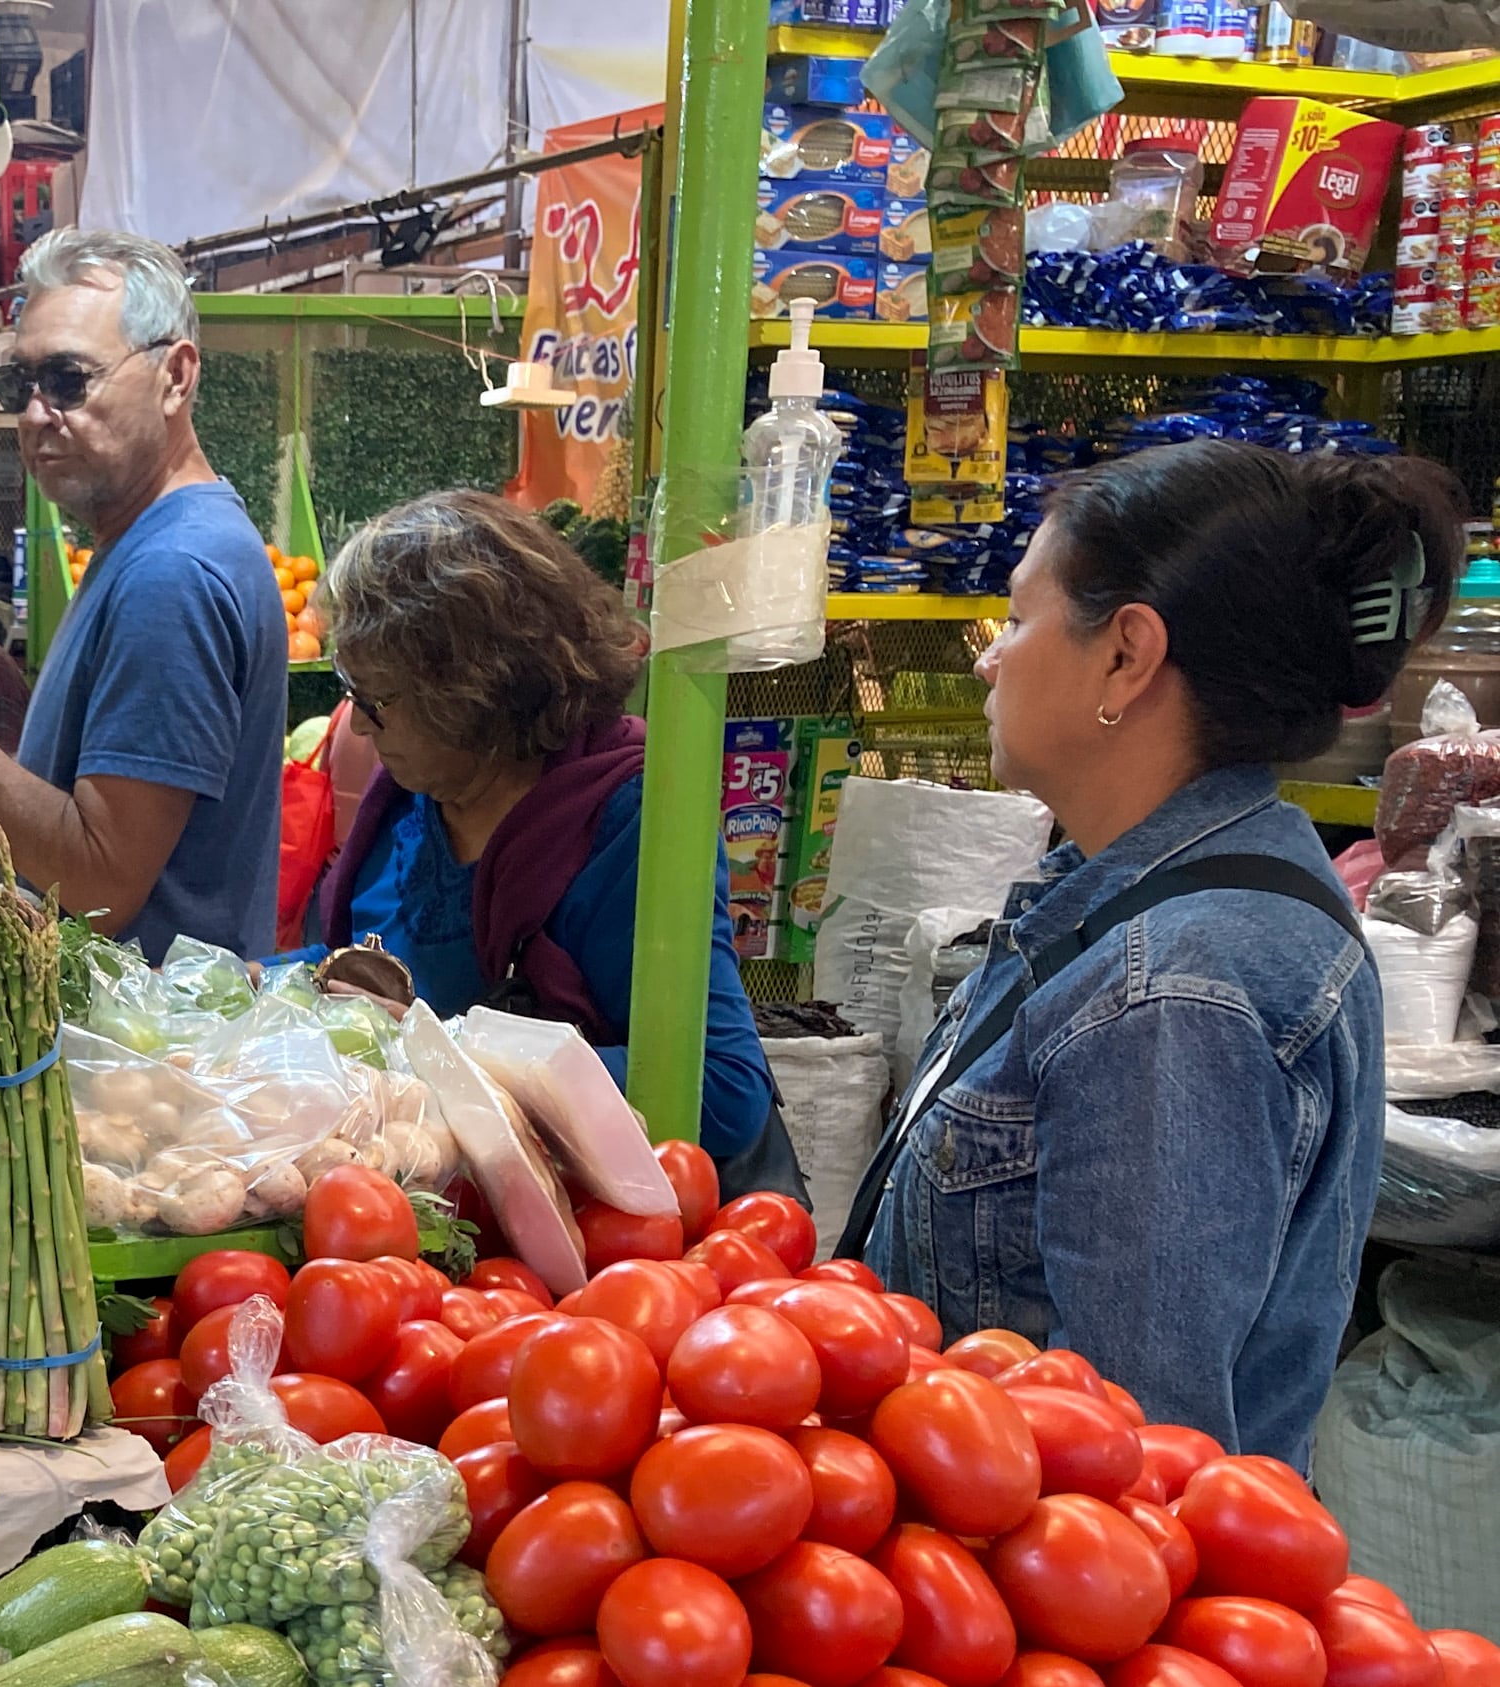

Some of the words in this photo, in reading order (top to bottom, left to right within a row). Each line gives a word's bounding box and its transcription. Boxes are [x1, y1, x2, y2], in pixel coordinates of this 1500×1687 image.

[1318, 165, 1360, 200] Legal
[728, 755, 752, 791] 3
[752, 768, 781, 800] $5
[727, 813, 779, 835] RikoPollo
